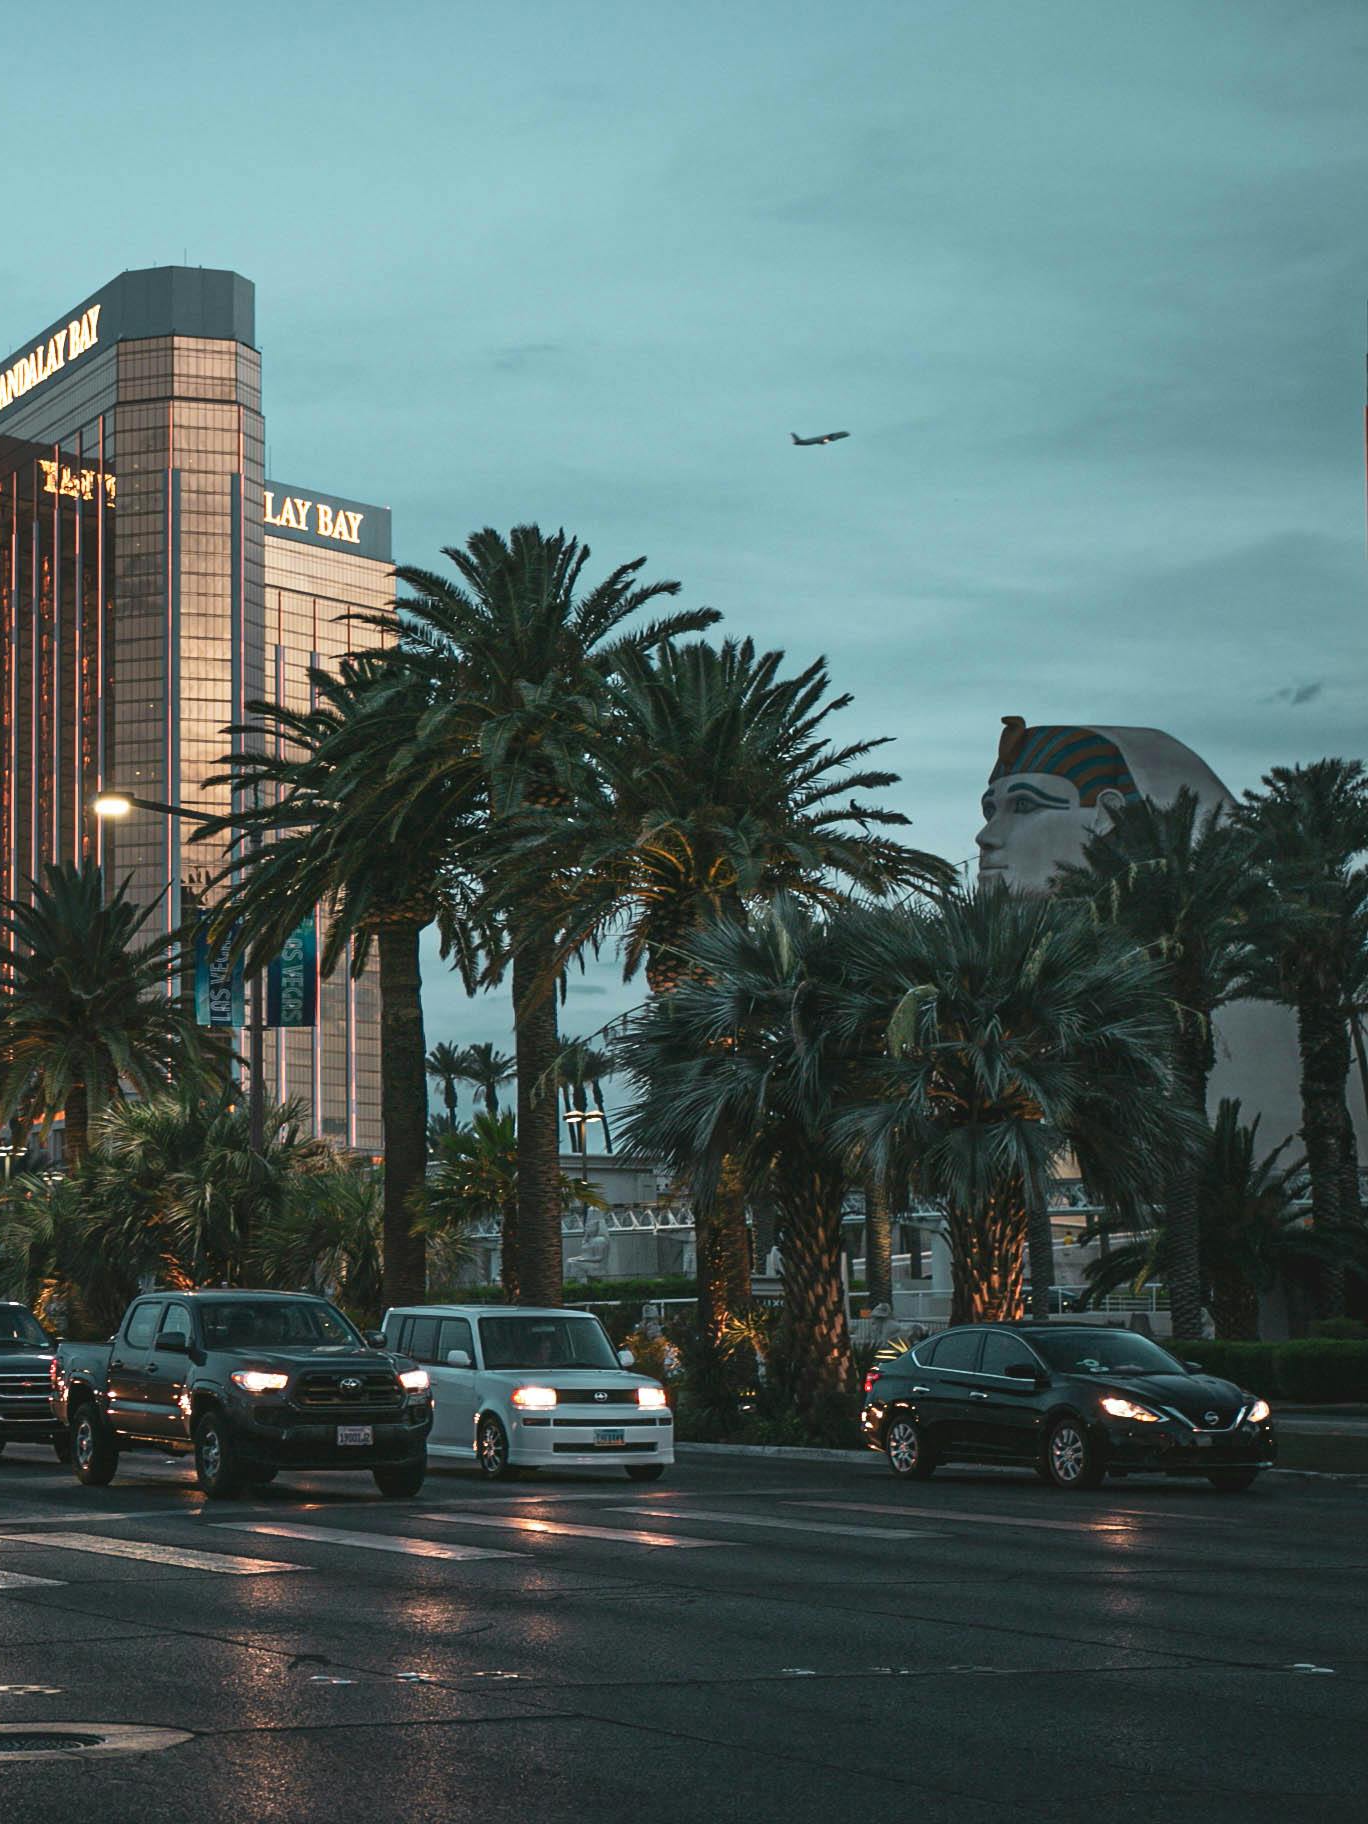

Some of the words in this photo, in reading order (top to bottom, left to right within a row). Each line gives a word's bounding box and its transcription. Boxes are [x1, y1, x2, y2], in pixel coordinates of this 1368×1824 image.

[67, 304, 101, 360] BAY
[316, 503, 364, 544] BAY
[210, 988, 232, 1022] LAS
[280, 964, 304, 1023] VEGAS
